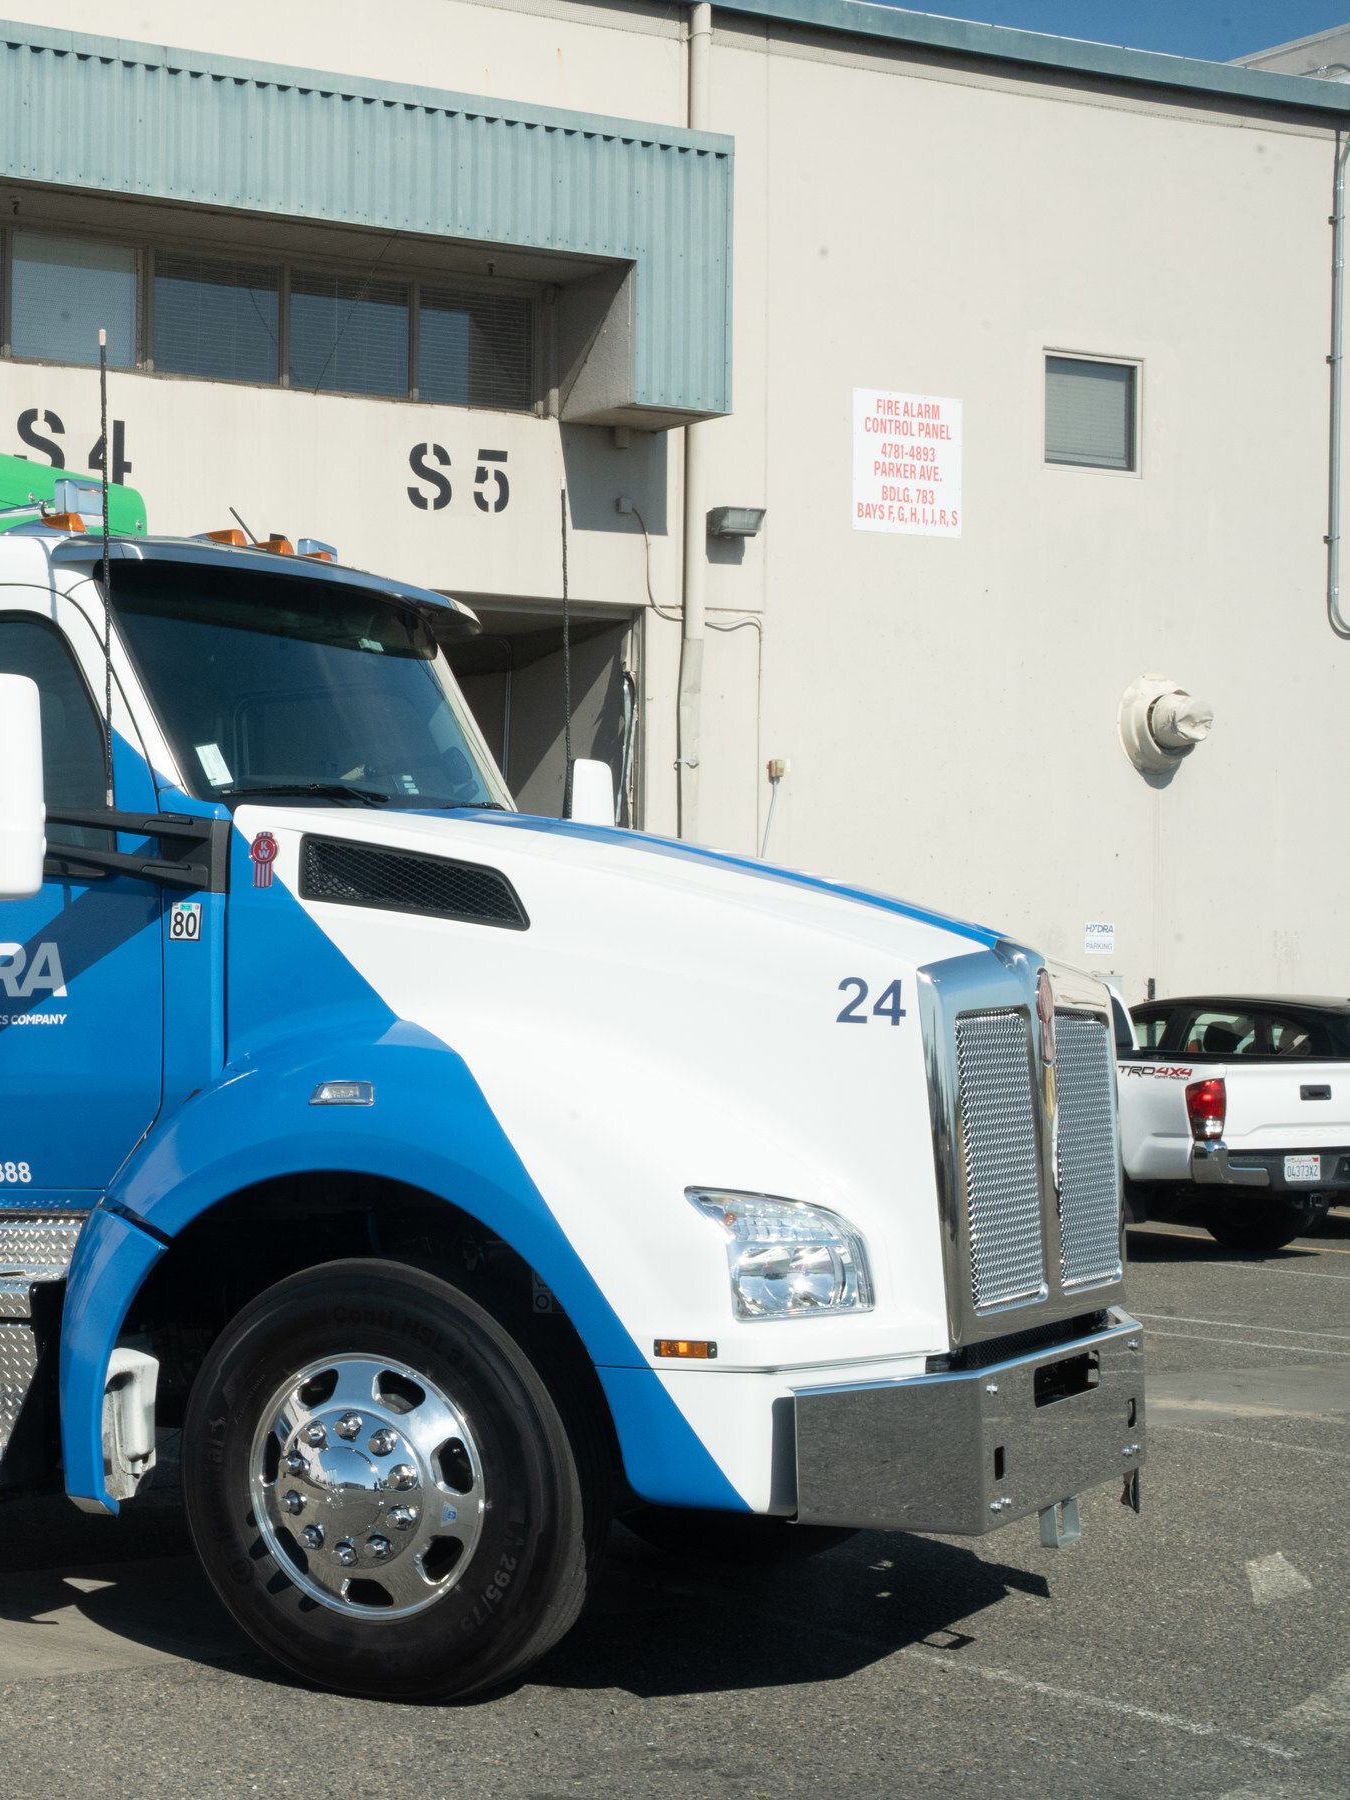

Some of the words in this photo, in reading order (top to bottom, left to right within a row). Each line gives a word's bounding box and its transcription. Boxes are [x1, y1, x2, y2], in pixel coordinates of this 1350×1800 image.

[876, 398, 900, 416] FIRE
[902, 401, 940, 420] ALARM
[864, 416, 915, 437] CONTROL
[918, 422, 952, 440] PANEL
[13, 408, 65, 470] S
[88, 420, 132, 486] 4
[881, 442, 936, 462] 4781-4893
[407, 442, 452, 511] S
[473, 449, 510, 513] 5
[873, 460, 916, 480] PARKER
[919, 465, 943, 482] AVE.
[881, 485, 913, 503] BDLG.
[915, 489, 935, 505] 783
[857, 502, 885, 520] BAYS
[888, 505, 895, 523] F,
[897, 506, 907, 524] G,
[910, 507, 920, 525] H,
[939, 509, 949, 527] R,
[951, 510, 958, 526] S
[172, 911, 197, 937] 80
[1085, 924, 1114, 933] HYDRA
[1085, 942, 1113, 951] PARKING
[836, 976, 907, 1026] 24
[11, 1013, 67, 1025] COMPANY
[1118, 1065, 1156, 1078] TRD
